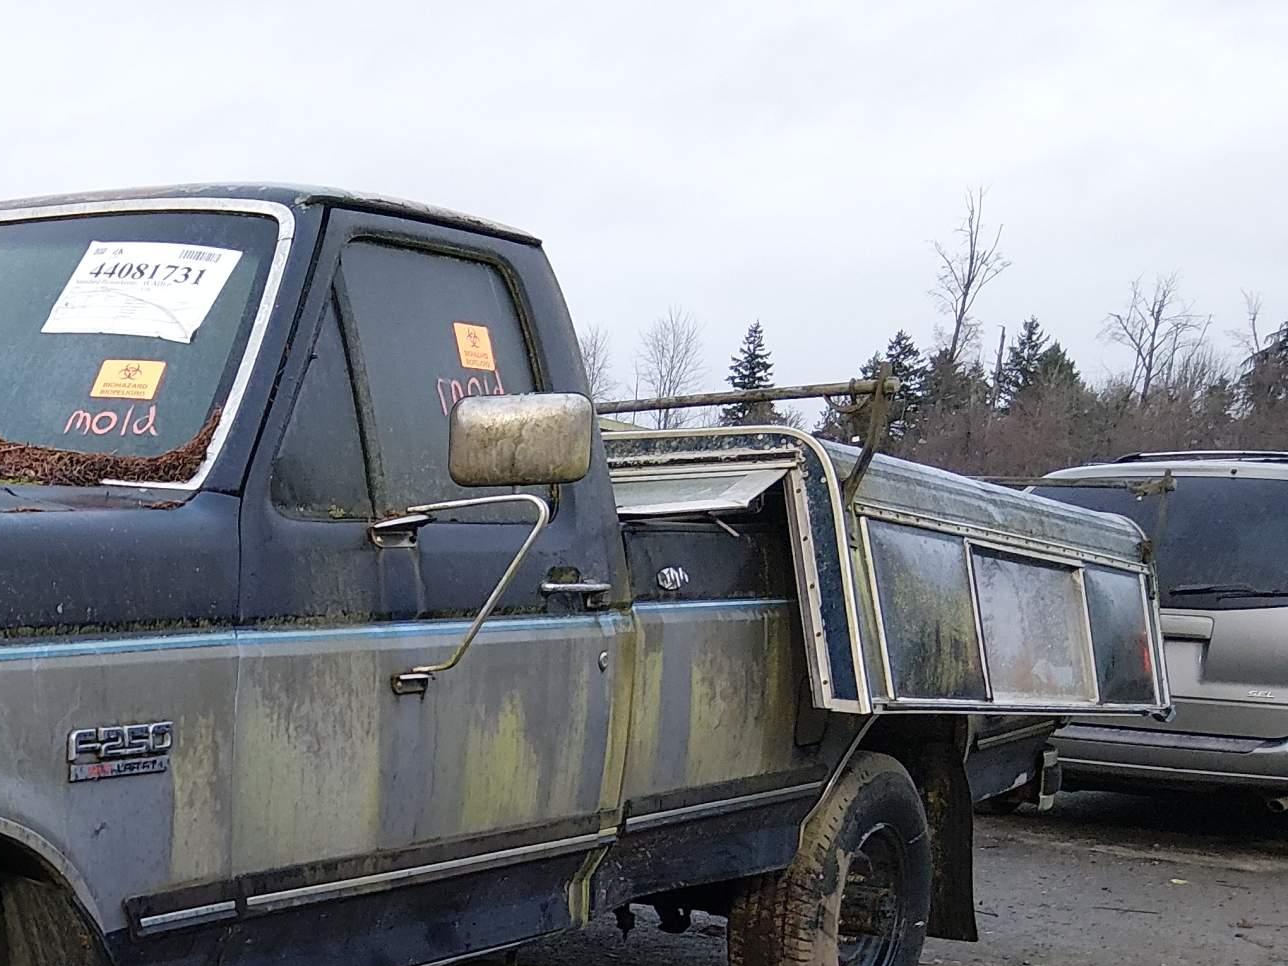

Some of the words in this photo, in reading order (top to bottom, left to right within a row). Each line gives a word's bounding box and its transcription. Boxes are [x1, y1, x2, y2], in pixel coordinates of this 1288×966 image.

[89, 262, 207, 285] 44081731
[64, 405, 159, 436] mold
[67, 721, 174, 761] F250
